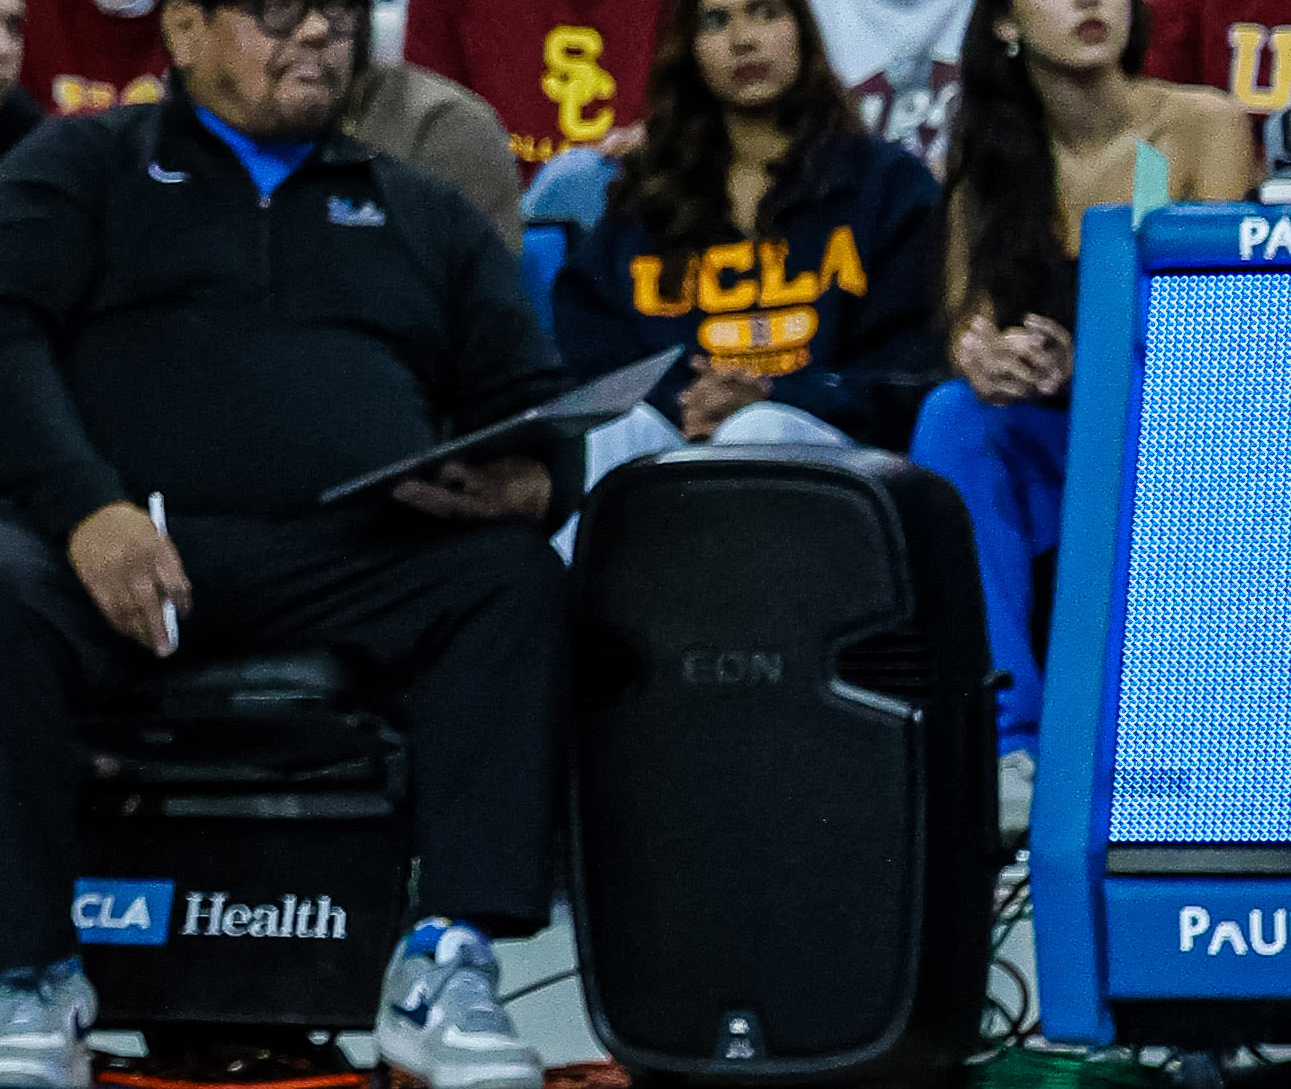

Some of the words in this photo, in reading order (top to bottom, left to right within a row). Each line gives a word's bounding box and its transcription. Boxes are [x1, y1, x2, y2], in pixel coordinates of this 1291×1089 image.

[542, 24, 617, 142] SC
[629, 225, 868, 316] UCLA
[70, 893, 152, 930] CLA
[181, 890, 347, 940] Health
[1179, 905, 1291, 956] PAU
